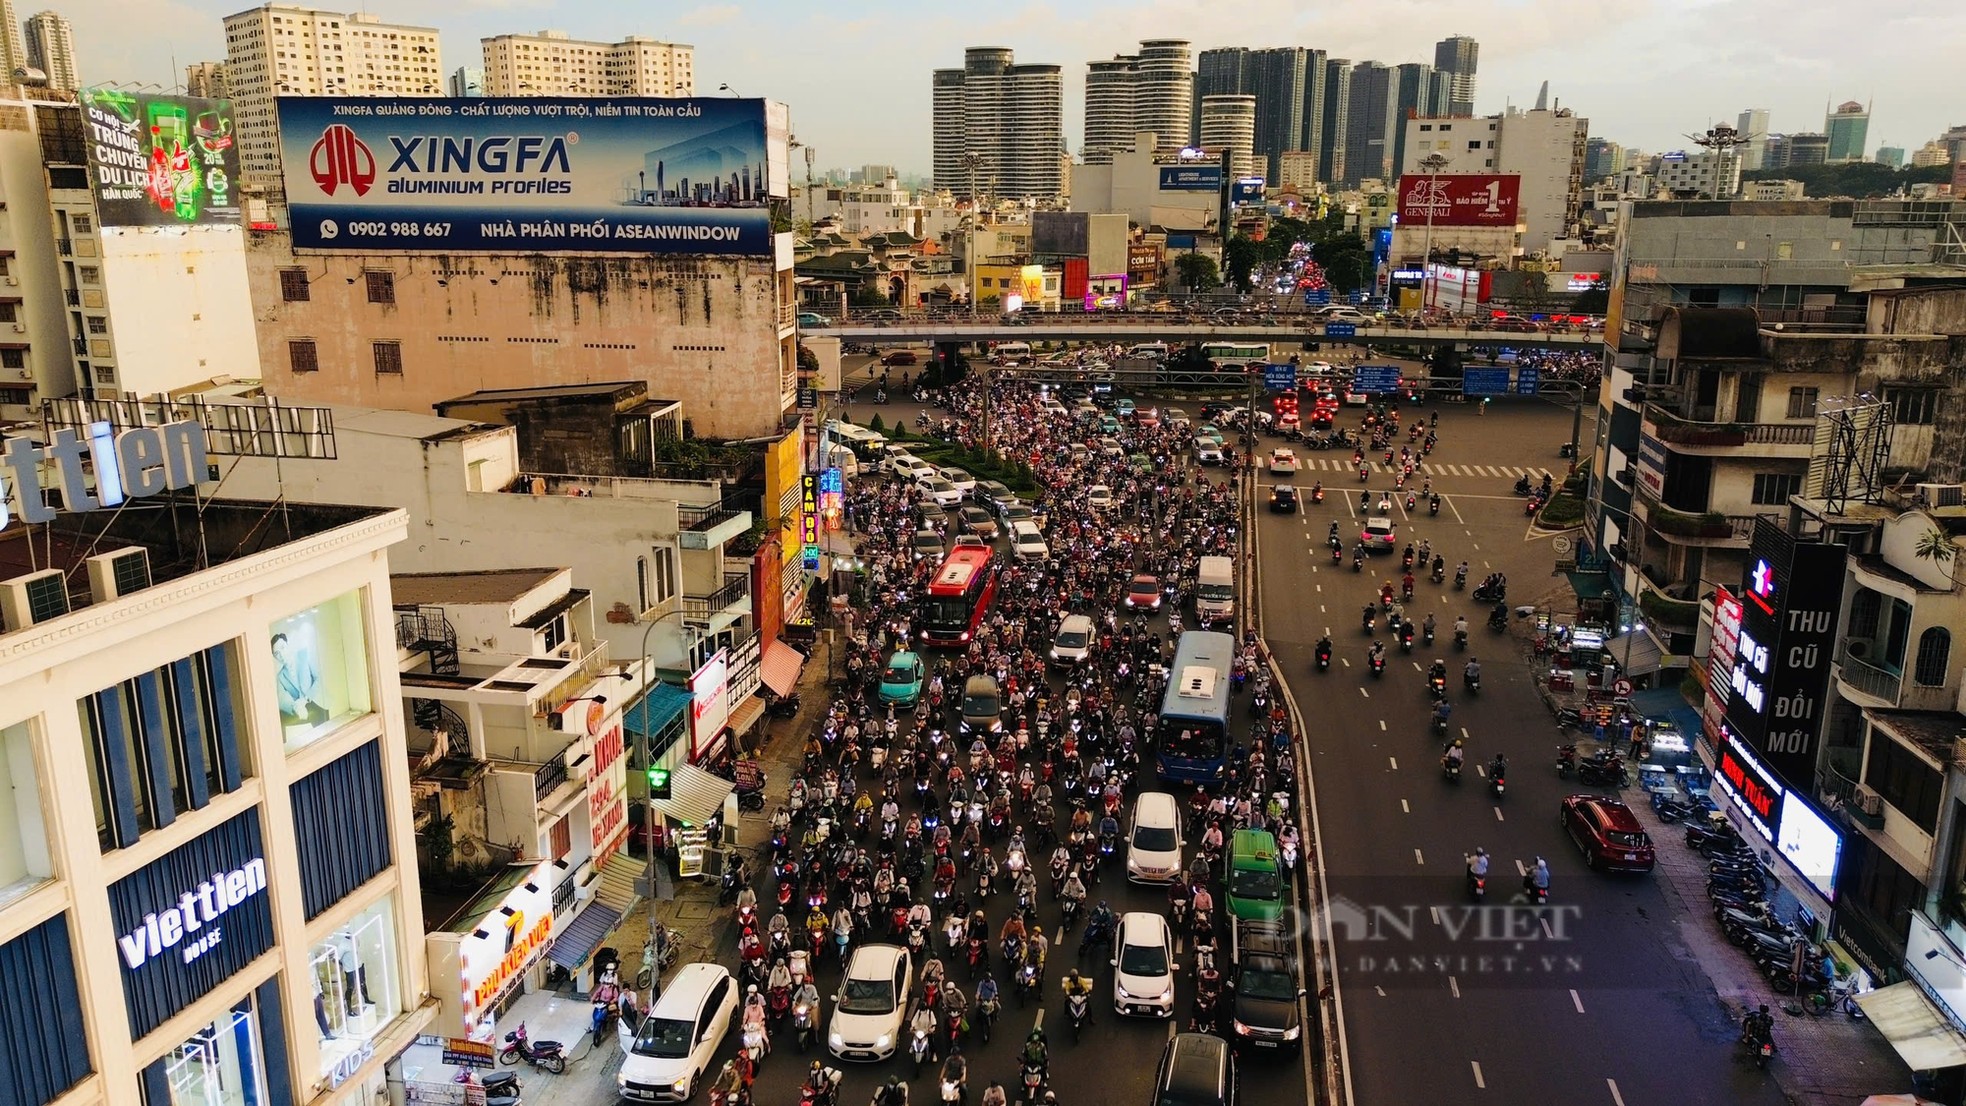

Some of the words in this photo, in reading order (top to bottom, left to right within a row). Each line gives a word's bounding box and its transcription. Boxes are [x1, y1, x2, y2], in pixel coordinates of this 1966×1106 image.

[89, 107, 103, 121] CƠ
[104, 113, 120, 129] HỘI
[334, 105, 373, 115] XINGFA
[376, 102, 416, 116] QUẢNG
[418, 102, 452, 115] ĐÔNG
[461, 102, 490, 116] CHẤT
[493, 104, 530, 118] LƯỢNG
[533, 104, 562, 118] VƯỢT
[565, 104, 592, 118] TRỘI,
[624, 106, 640, 116] TIN
[643, 103, 674, 117] TOÀN
[90, 122, 139, 152] TRÚNG
[96, 144, 148, 170] CHUYẾN
[387, 137, 571, 173] XINGFA
[99, 166, 121, 184] DU
[124, 170, 150, 188] LỊCH
[102, 187, 120, 199] HÀN
[1485, 181, 1499, 212] 1
[1405, 208, 1450, 217] GENERALI
[349, 222, 387, 236] 0902
[391, 222, 419, 236] 988
[423, 222, 451, 236] 667
[480, 219, 516, 237] NHÀ
[520, 220, 565, 237] PHÂN
[570, 218, 609, 238] PHỐI
[614, 224, 740, 240] ASEANWINDOW
[1789, 610, 1831, 634] THU
[1789, 644, 1818, 669] CŨ
[1775, 688, 1813, 719] ĐỔI
[1768, 729, 1809, 754] MỚI
[591, 778, 611, 818] 294
[118, 857, 267, 971] viettien
[183, 927, 222, 964] HOUSE
[1840, 925, 1886, 984] Vietcombank
[475, 968, 499, 1007] PHỤ
[501, 940, 529, 978] KIỆN
[328, 1039, 374, 1092] KIDS
